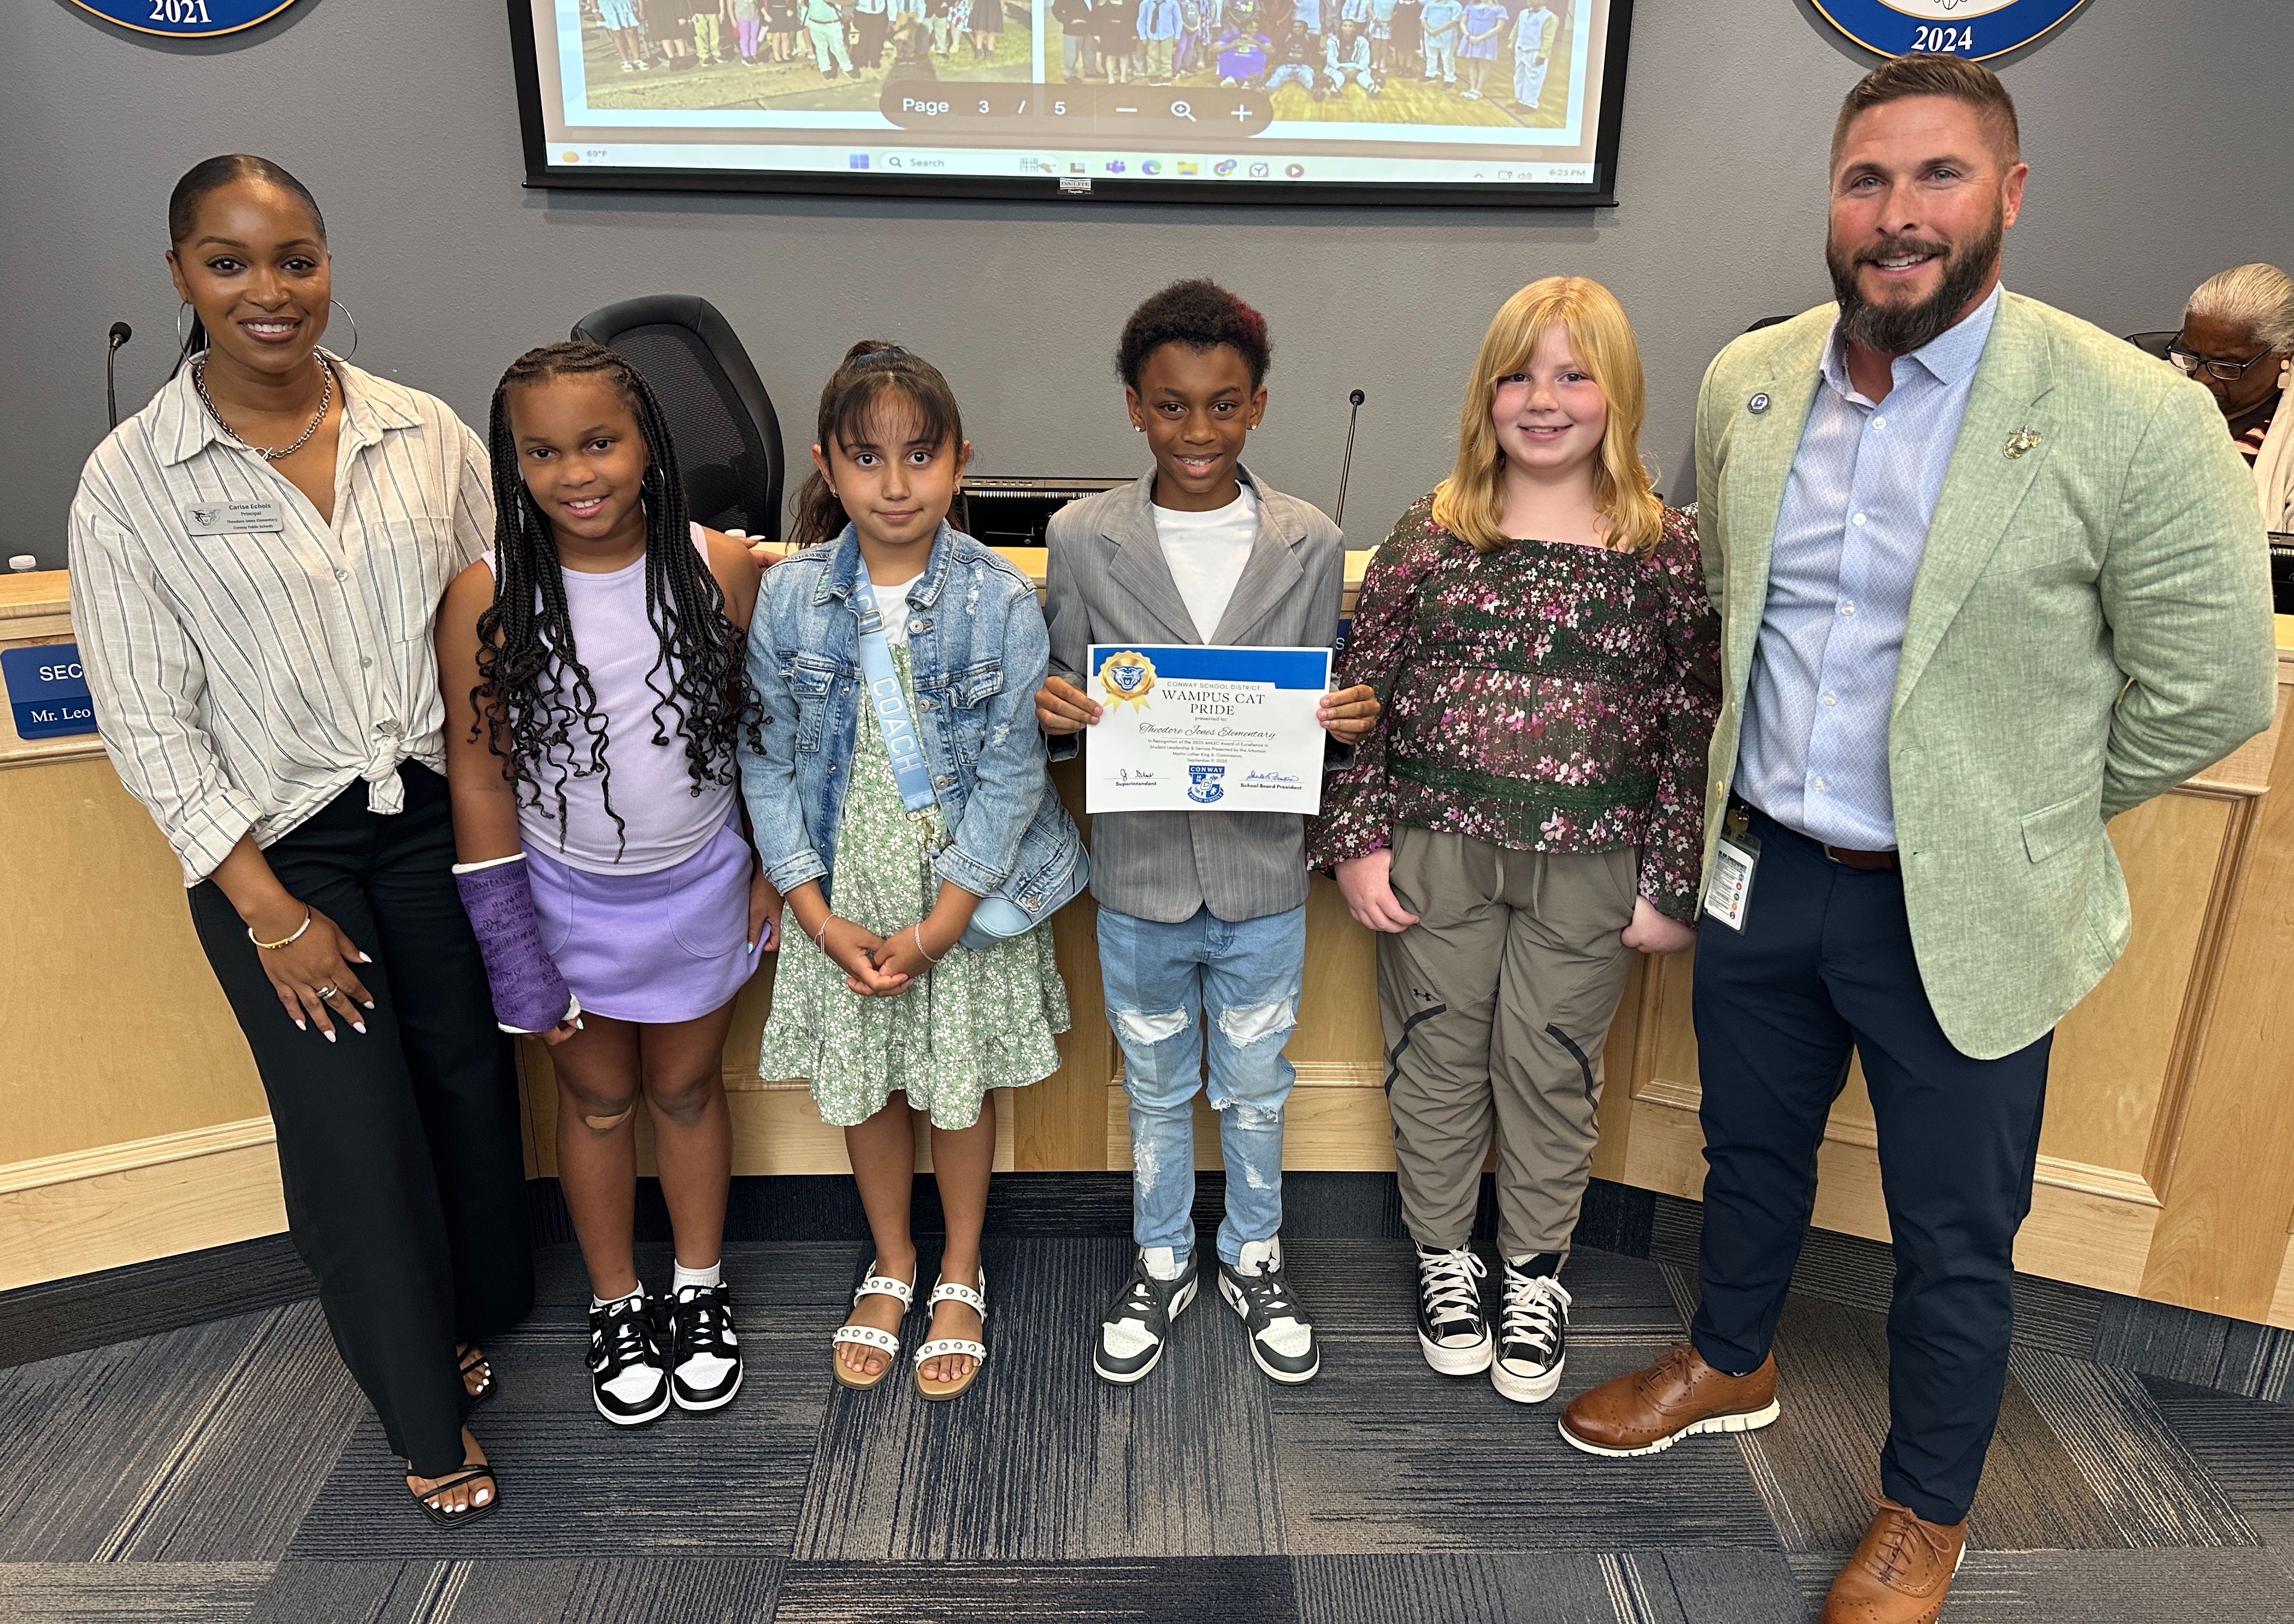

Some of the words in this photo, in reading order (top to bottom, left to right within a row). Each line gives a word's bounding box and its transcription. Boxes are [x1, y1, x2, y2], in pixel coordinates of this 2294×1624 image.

[149, 0, 212, 23] 2021
[1910, 26, 1972, 52] 2024
[903, 98, 950, 116] Page
[978, 100, 990, 113] 3
[1018, 100, 1026, 114] /
[1054, 101, 1066, 115] 5
[910, 158, 945, 167] Search
[1162, 689, 1229, 703] WAMPUS
[1235, 693, 1265, 704] CAT
[31, 710, 58, 723] Mr.
[61, 707, 91, 720] Leo
[1190, 703, 1234, 715] PRIDE
[872, 676, 921, 774] COACH
[1139, 722, 1183, 734] Theodore
[1185, 724, 1215, 736] Jones
[1217, 726, 1276, 740] Elementary
